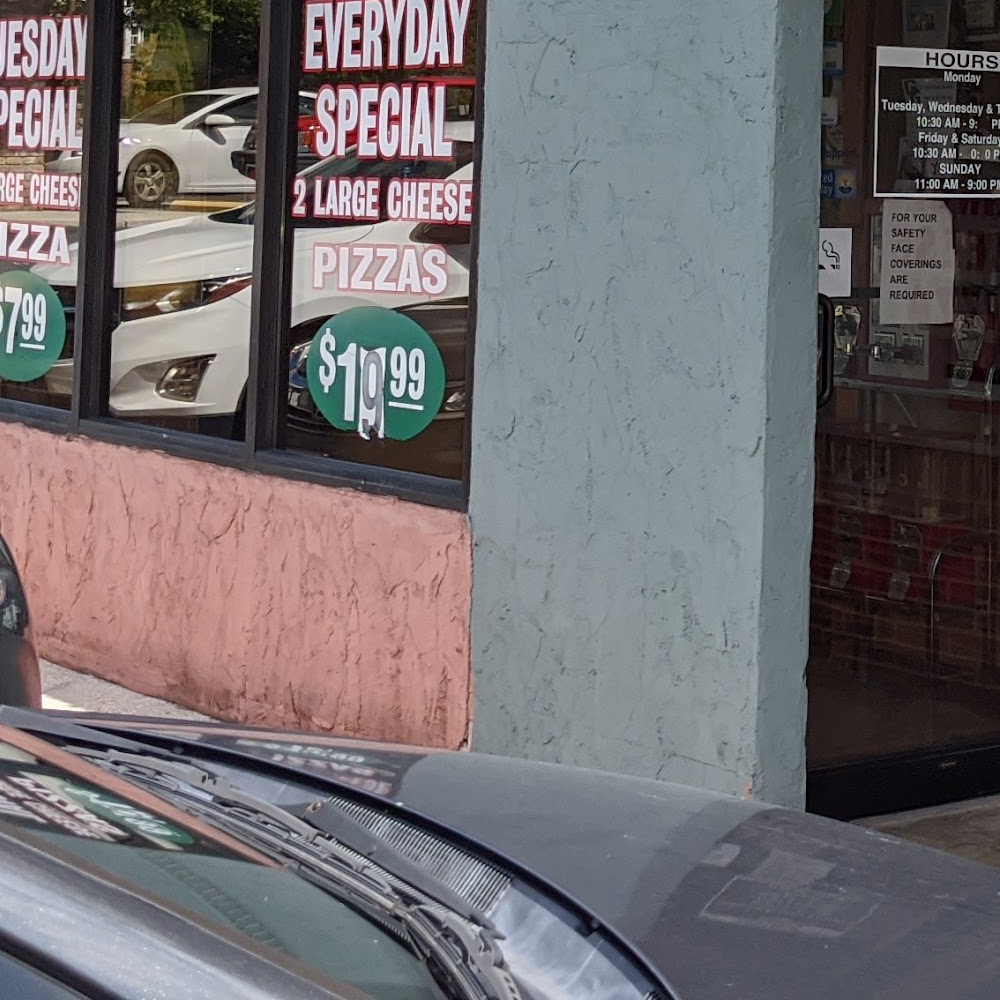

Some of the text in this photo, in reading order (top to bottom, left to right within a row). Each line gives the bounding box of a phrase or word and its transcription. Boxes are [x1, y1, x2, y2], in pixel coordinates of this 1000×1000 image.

[926, 52, 999, 69] HOURS
[943, 71, 982, 85] Monday
[881, 99, 926, 114] Tuesday,
[928, 101, 984, 115] Wednesday
[986, 104, 993, 115] &
[315, 83, 453, 160] SPECIAL
[916, 117, 942, 128] 10:30
[945, 118, 960, 129] AM
[918, 132, 949, 147] Friday
[951, 133, 959, 144] &
[913, 147, 938, 159] 10:30
[941, 148, 956, 159] AM
[939, 164, 981, 175] SUNDAY
[914, 178, 940, 190] 11:00
[943, 179, 959, 190] AM
[967, 180, 988, 191] 9:00
[292, 178, 472, 223] 2 LARGE CHEESE
[891, 213, 937, 222] FOR YOUR
[891, 228, 926, 238] SAFETY
[891, 243, 914, 253] FACE
[312, 243, 448, 296] PIZZAS
[890, 259, 942, 269] COVERINGS
[890, 275, 908, 284] ARE
[889, 290, 934, 300] REQUIRED
